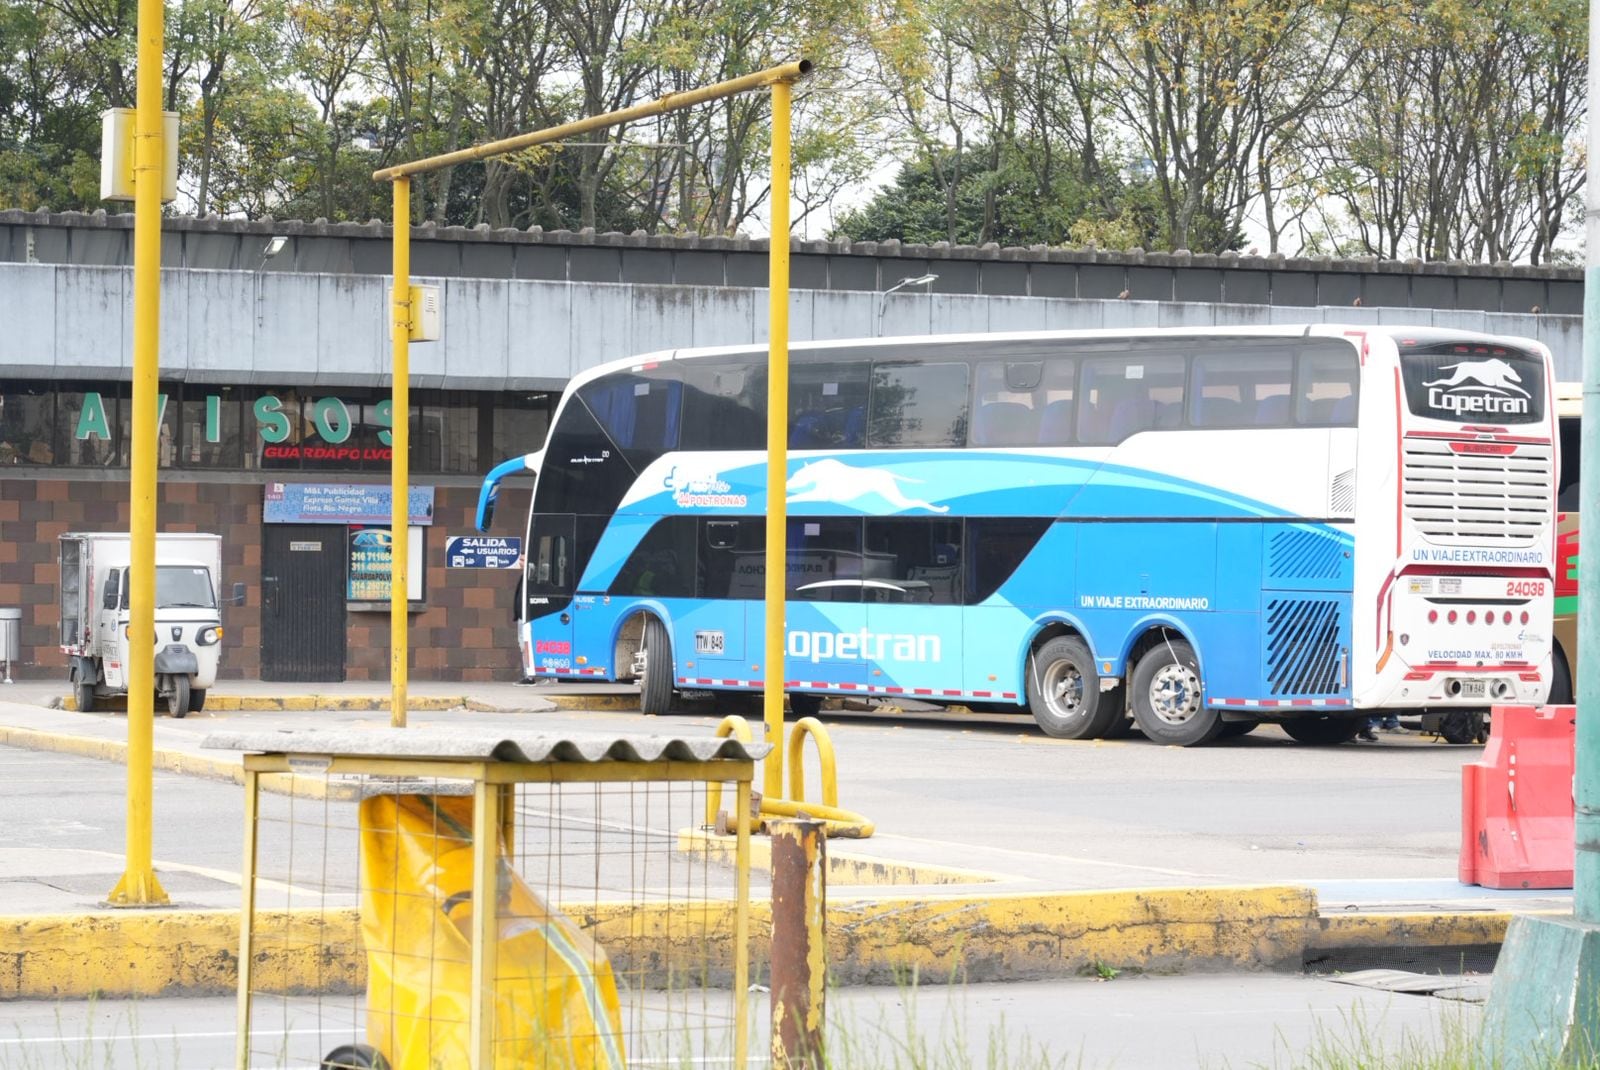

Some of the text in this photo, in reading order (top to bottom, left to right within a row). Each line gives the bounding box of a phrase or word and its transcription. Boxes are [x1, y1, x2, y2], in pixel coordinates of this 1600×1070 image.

[1429, 387, 1528, 416] Copetran
[75, 392, 392, 446] AISOS
[324, 487, 365, 496] Publicidad
[690, 496, 746, 505] POLTRONAS
[463, 539, 507, 547] SALIDA
[1413, 549, 1543, 563] UN VIAJE EXTRAORDINARIO
[1507, 582, 1545, 596] 24038
[1081, 595, 1209, 609] UN VIAJE EXTRAORDINARIO
[536, 640, 571, 654] 24038
[696, 635, 723, 650] TTW 848
[784, 621, 941, 663] opetran
[1428, 650, 1472, 659] VELOCIDAD
[1474, 651, 1493, 659] MAX.
